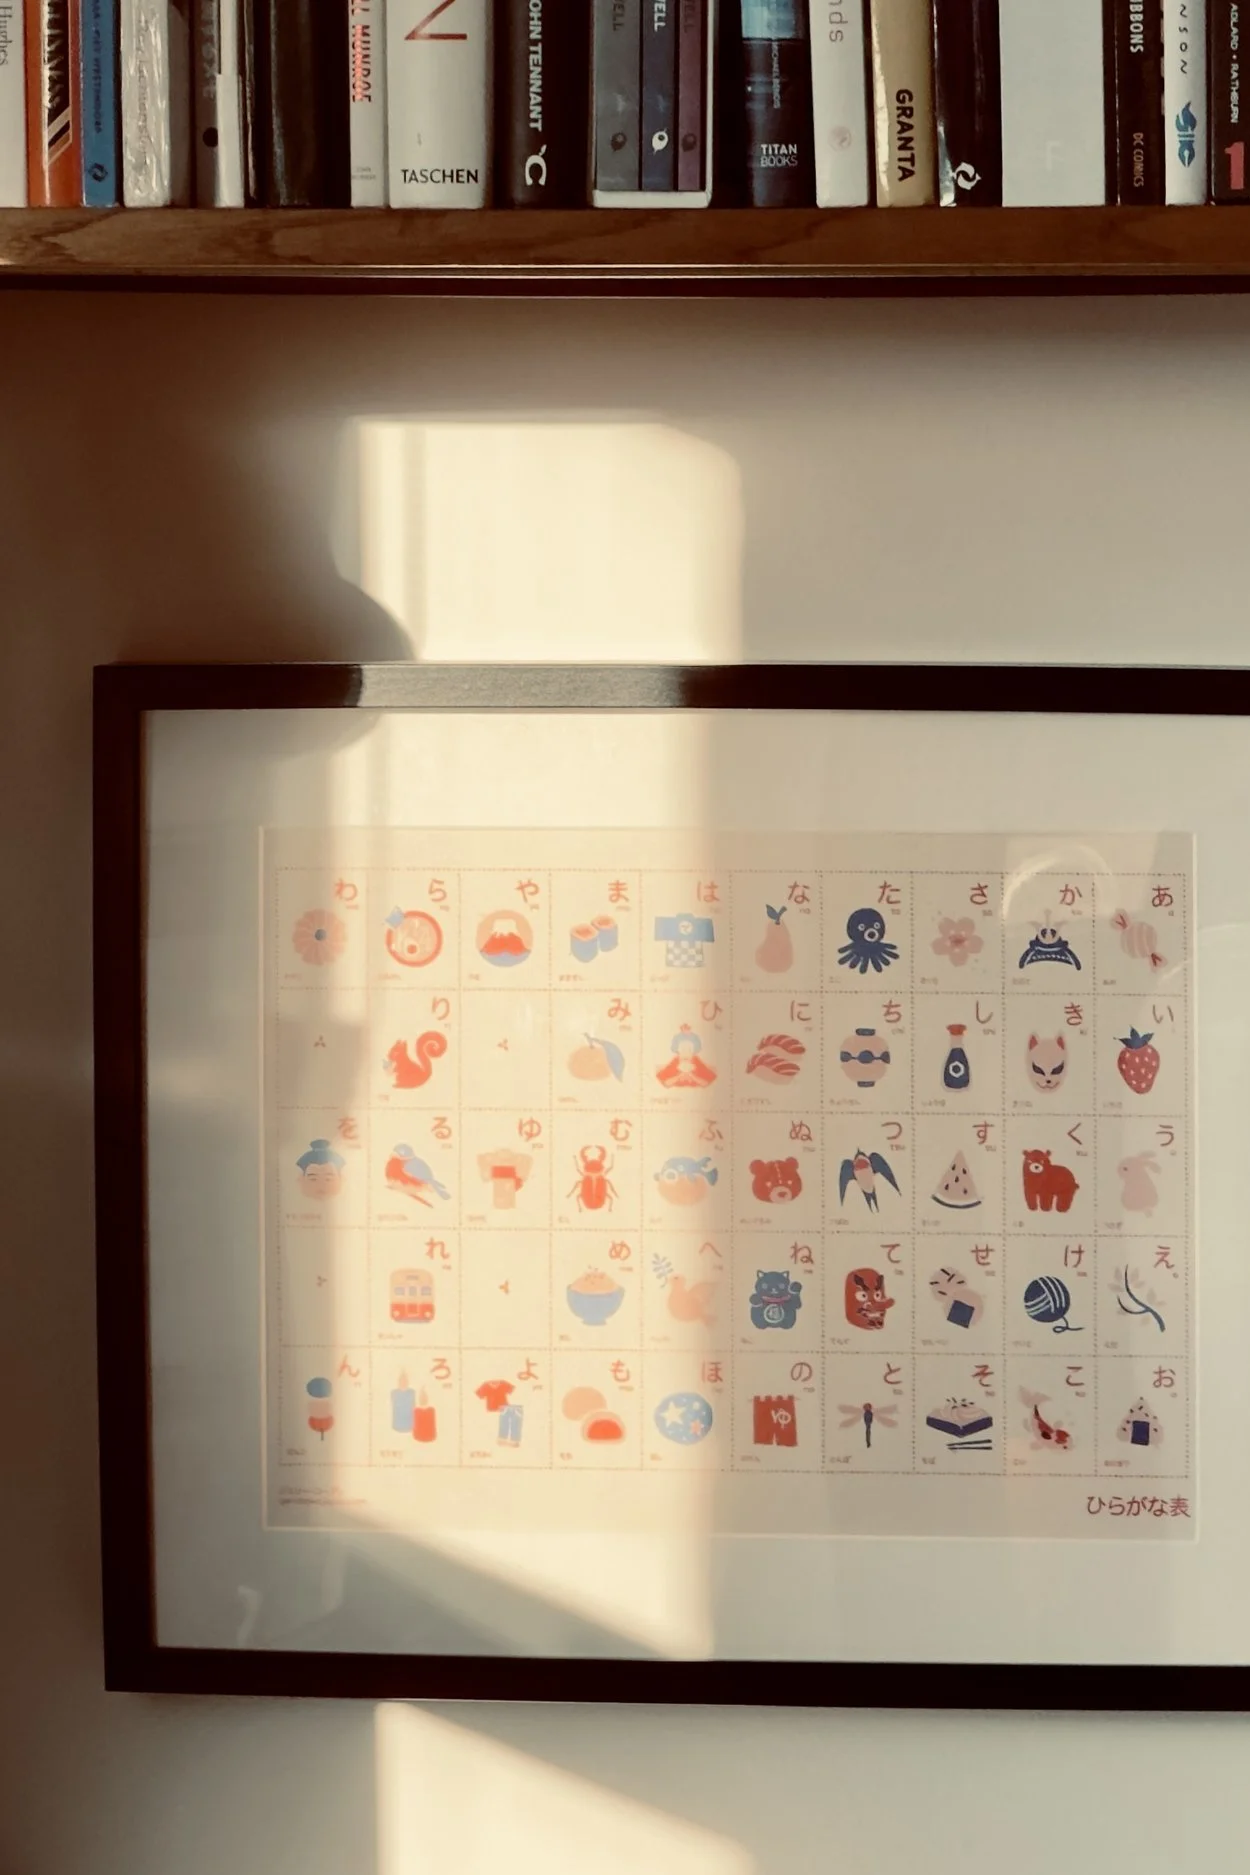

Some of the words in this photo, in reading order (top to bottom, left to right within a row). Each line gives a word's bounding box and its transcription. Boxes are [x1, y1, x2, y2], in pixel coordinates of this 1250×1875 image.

[1230, 3, 1239, 50] ADLARD
[352, 24, 372, 103] MUNROE
[529, 43, 543, 132] TENNANT
[1230, 63, 1239, 124] RATHBURN
[895, 88, 915, 182] GRANTA
[1133, 132, 1144, 146] DC
[761, 143, 797, 154] TITAN
[761, 155, 797, 166] BOOKS
[1133, 149, 1144, 187] COMICS
[1225, 141, 1245, 190] 1
[401, 168, 479, 184] TASCHEN
[335, 879, 358, 901] わ
[429, 879, 448, 902] ら
[516, 879, 540, 902] や
[608, 881, 630, 902] ま
[697, 882, 719, 902] は
[788, 882, 811, 903] な
[878, 882, 902, 902] た
[970, 883, 988, 904] さ
[1059, 884, 1082, 905] か
[1151, 886, 1174, 907] あ
[432, 996, 450, 1019] り
[608, 999, 631, 1019] み
[701, 1000, 723, 1021] ひ
[790, 1001, 812, 1022] に
[882, 1001, 902, 1022] ち
[975, 1002, 993, 1022] し
[1064, 1003, 1084, 1026] き
[1152, 1005, 1174, 1022] い
[338, 1116, 358, 1140] を
[432, 1117, 452, 1139] る
[519, 1118, 541, 1139] ゆ
[610, 1119, 632, 1141] む
[700, 1119, 724, 1141] ふ
[790, 1121, 812, 1141] ぬ
[881, 1124, 903, 1140] つ
[972, 1122, 995, 1144] す
[1067, 1123, 1083, 1144] く
[1157, 1124, 1174, 1146] う
[426, 1238, 450, 1260] れ
[609, 1241, 631, 1260] め
[700, 1242, 722, 1258] へ
[790, 1242, 814, 1264] ね
[880, 1244, 902, 1264] て
[970, 1244, 995, 1266] せ
[1064, 1245, 1084, 1267] け
[1155, 1246, 1175, 1268] え
[338, 1355, 360, 1378] ん
[432, 1359, 451, 1379] ろ
[517, 1359, 539, 1380] よ
[610, 1361, 630, 1382] も
[702, 1362, 724, 1383] ほ
[791, 1362, 812, 1381] の
[884, 1362, 902, 1384] と
[972, 1365, 995, 1386] そ
[1065, 1366, 1084, 1386] こ
[1153, 1366, 1176, 1388] お
[1086, 1496, 1190, 1517] ひらがな表
